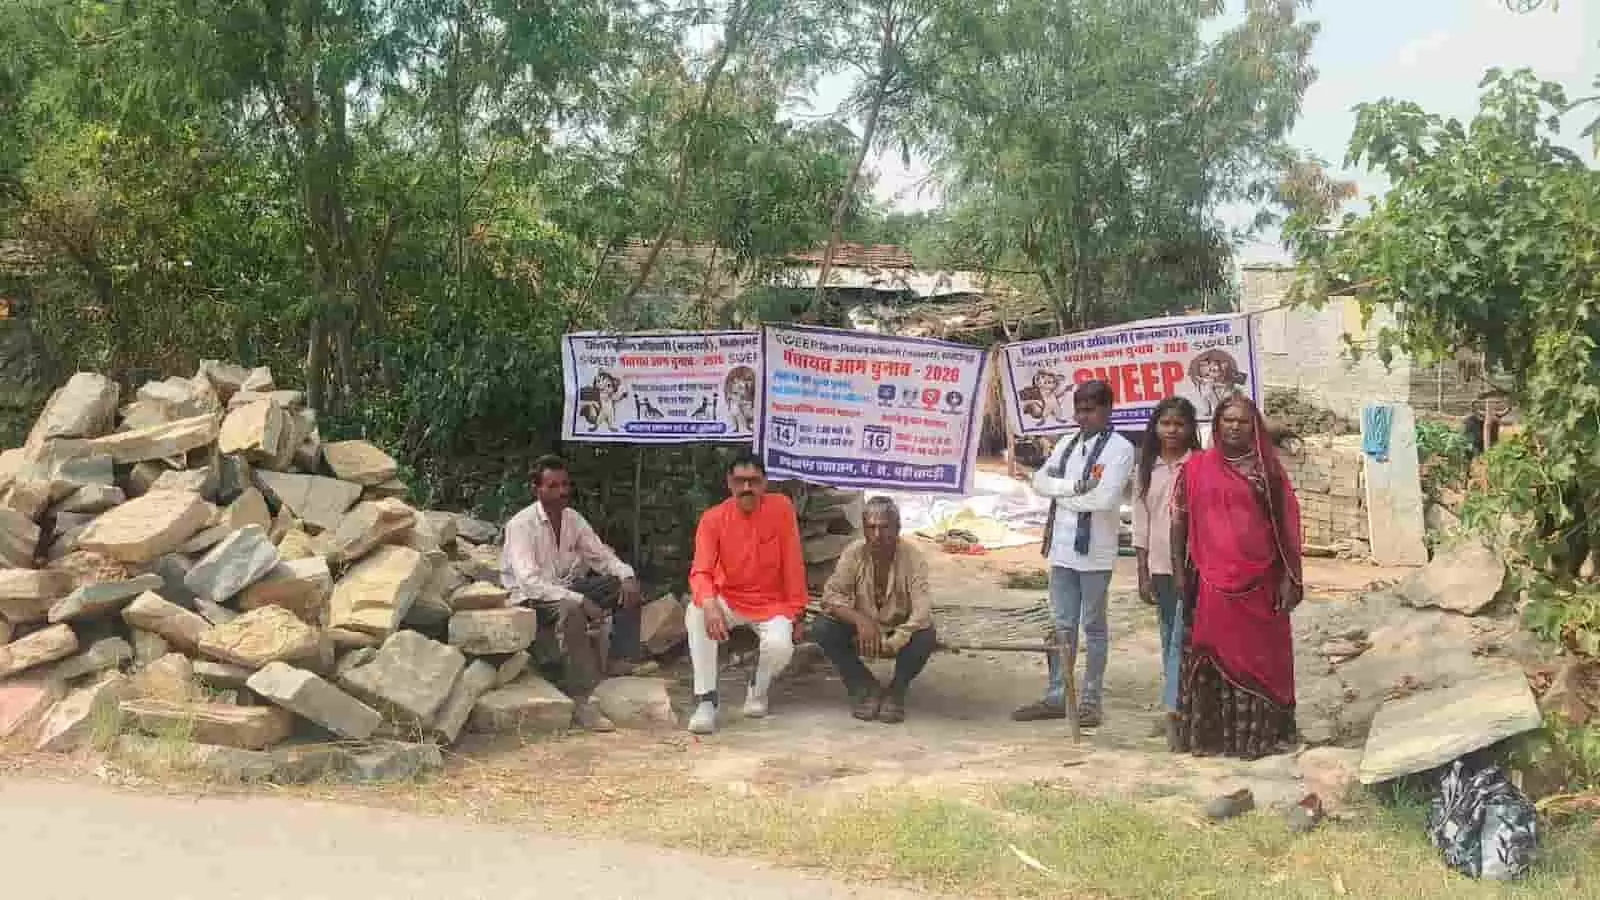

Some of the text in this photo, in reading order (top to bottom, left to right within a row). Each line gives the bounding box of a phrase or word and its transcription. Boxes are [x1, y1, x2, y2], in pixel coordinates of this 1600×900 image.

[783, 349, 832, 372] पंचायत
[833, 359, 866, 375] आम
[871, 361, 912, 381] चुनाव
[867, 433, 885, 448] 16
